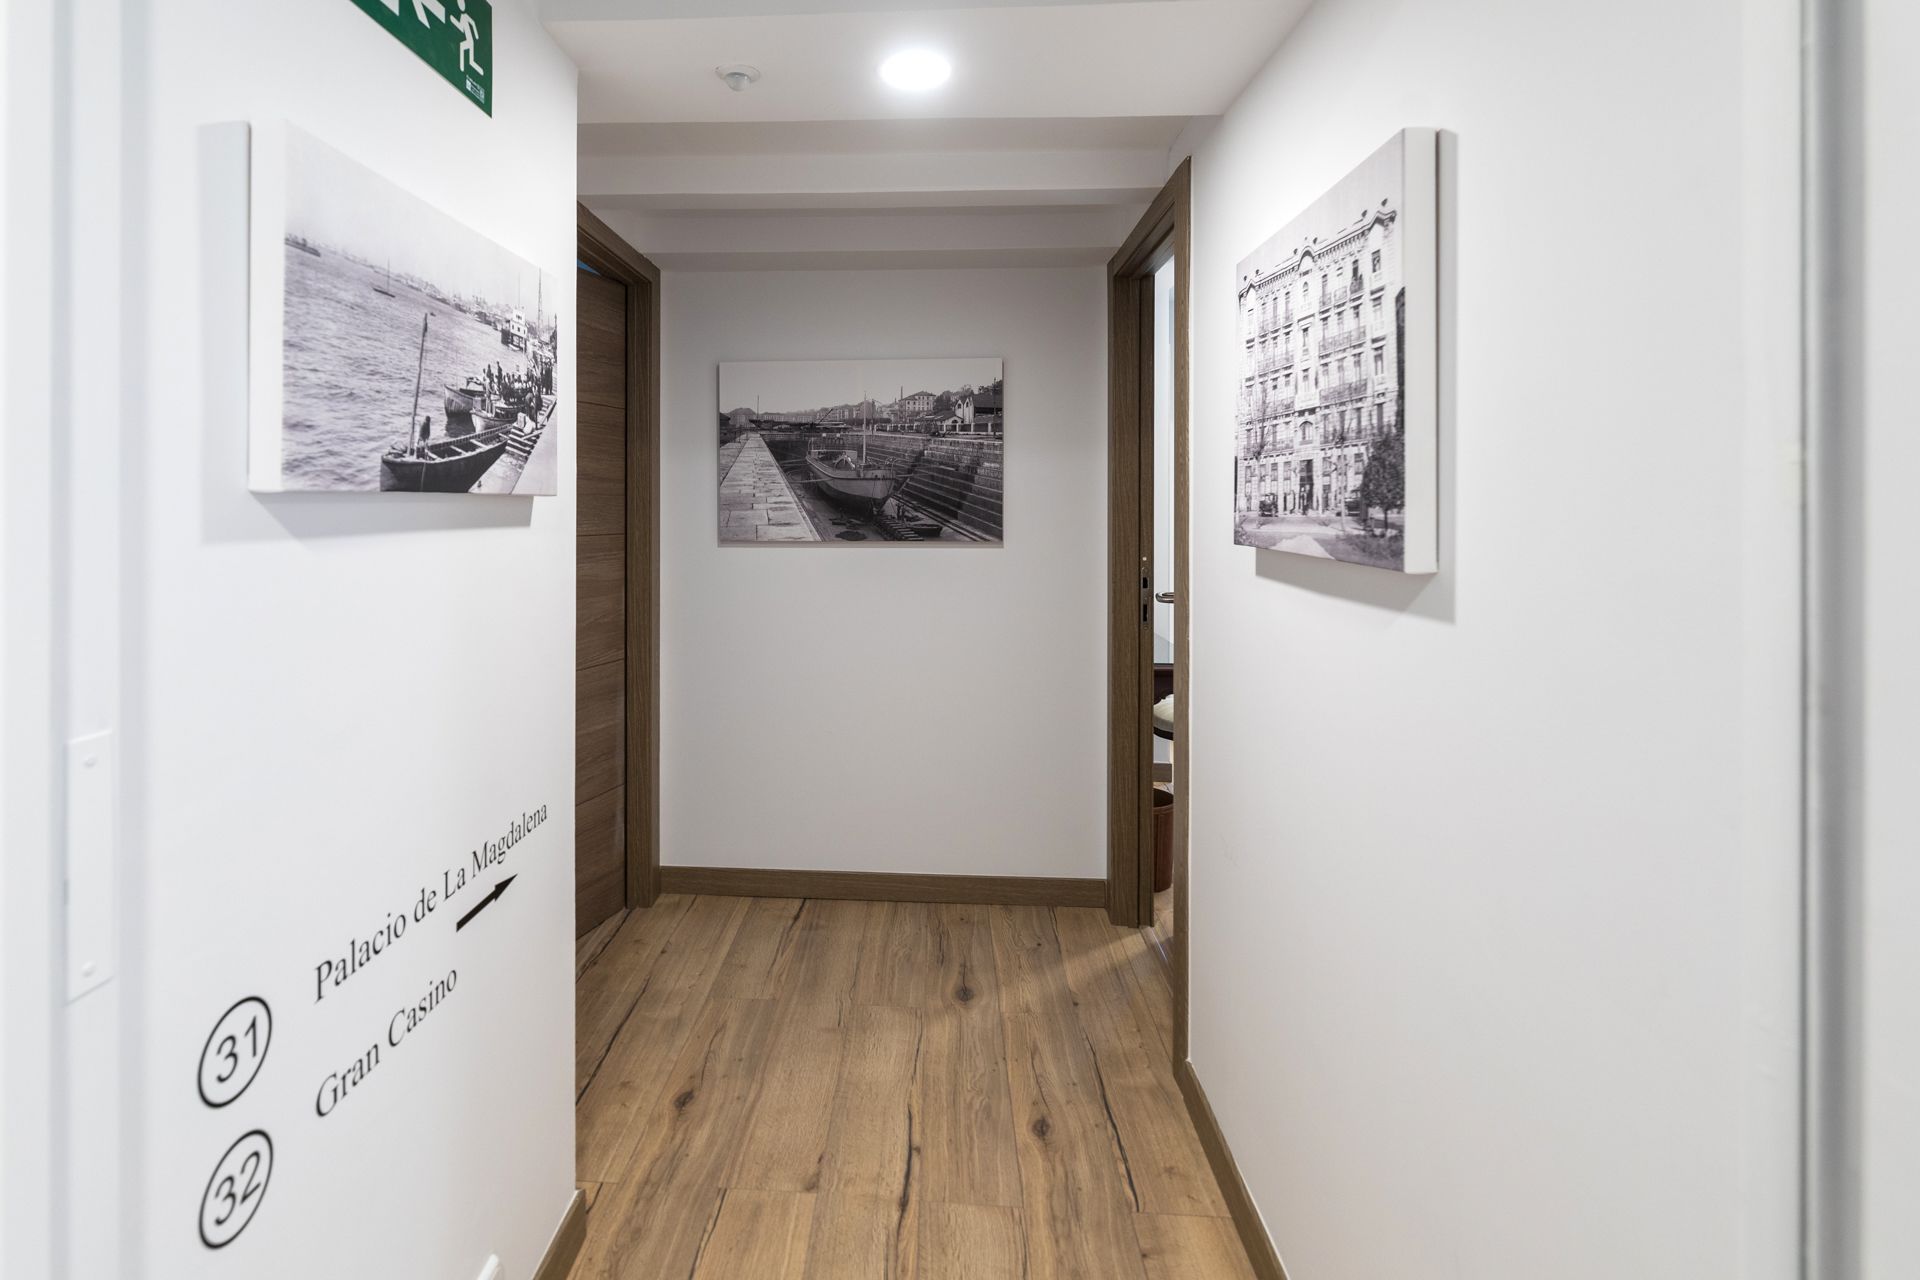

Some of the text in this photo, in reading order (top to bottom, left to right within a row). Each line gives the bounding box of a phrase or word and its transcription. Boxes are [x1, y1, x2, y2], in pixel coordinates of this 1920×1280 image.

[215, 803, 548, 1085] 31 Palacio de La Magdalena
[213, 968, 457, 1227] 32 Gran Casino
